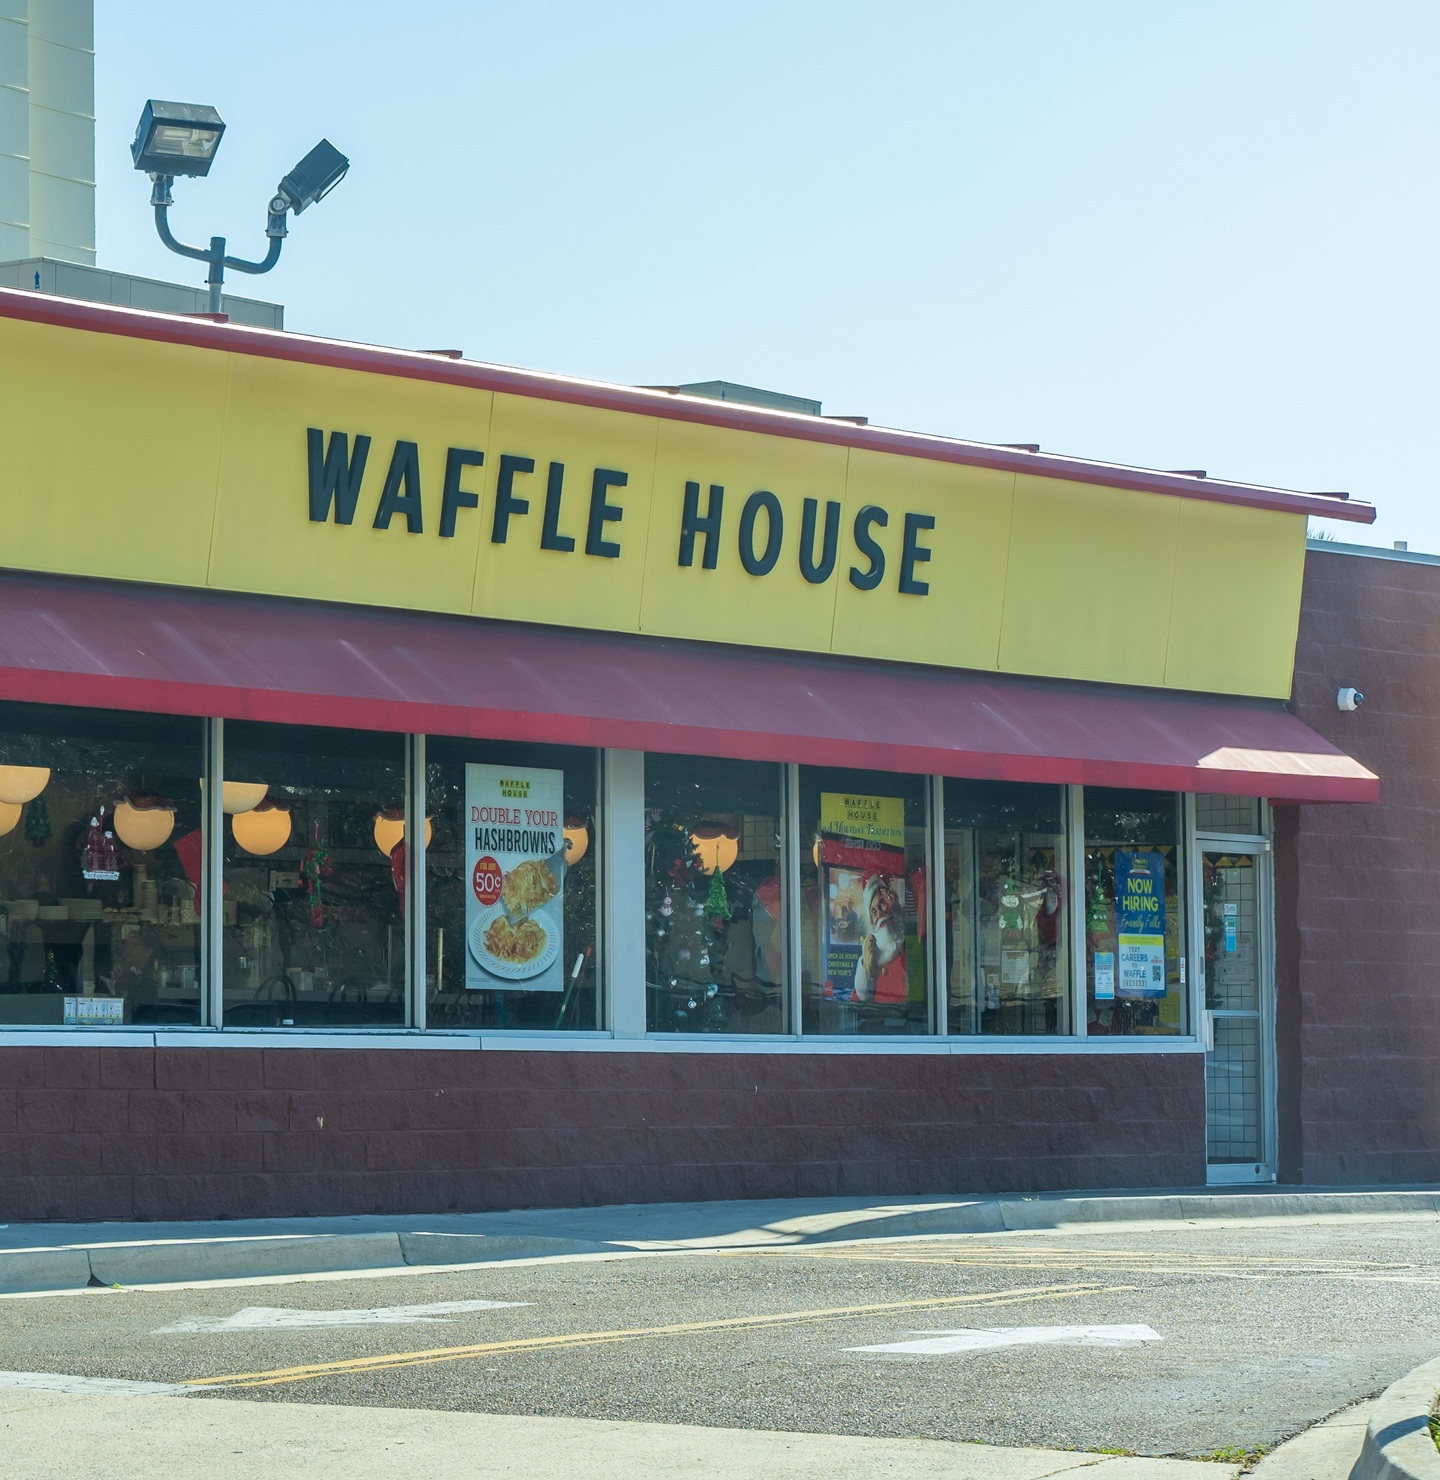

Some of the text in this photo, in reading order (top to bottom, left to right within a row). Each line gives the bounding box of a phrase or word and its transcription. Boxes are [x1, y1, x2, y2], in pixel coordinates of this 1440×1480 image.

[306, 427, 936, 596] WAFFLE HOUSE
[499, 779, 531, 790] WAFFLE
[502, 789, 529, 798] HOUSE
[844, 799, 881, 810] WAFFLE
[471, 806, 559, 828] DOUBLE YOUR
[848, 811, 878, 821] HOUSE
[474, 827, 556, 855] HASHBROWNS
[1127, 878, 1153, 894] NOW
[1122, 896, 1159, 912] HIRING
[1121, 953, 1149, 963] CAREERS
[1123, 969, 1147, 979] WAFFLE
